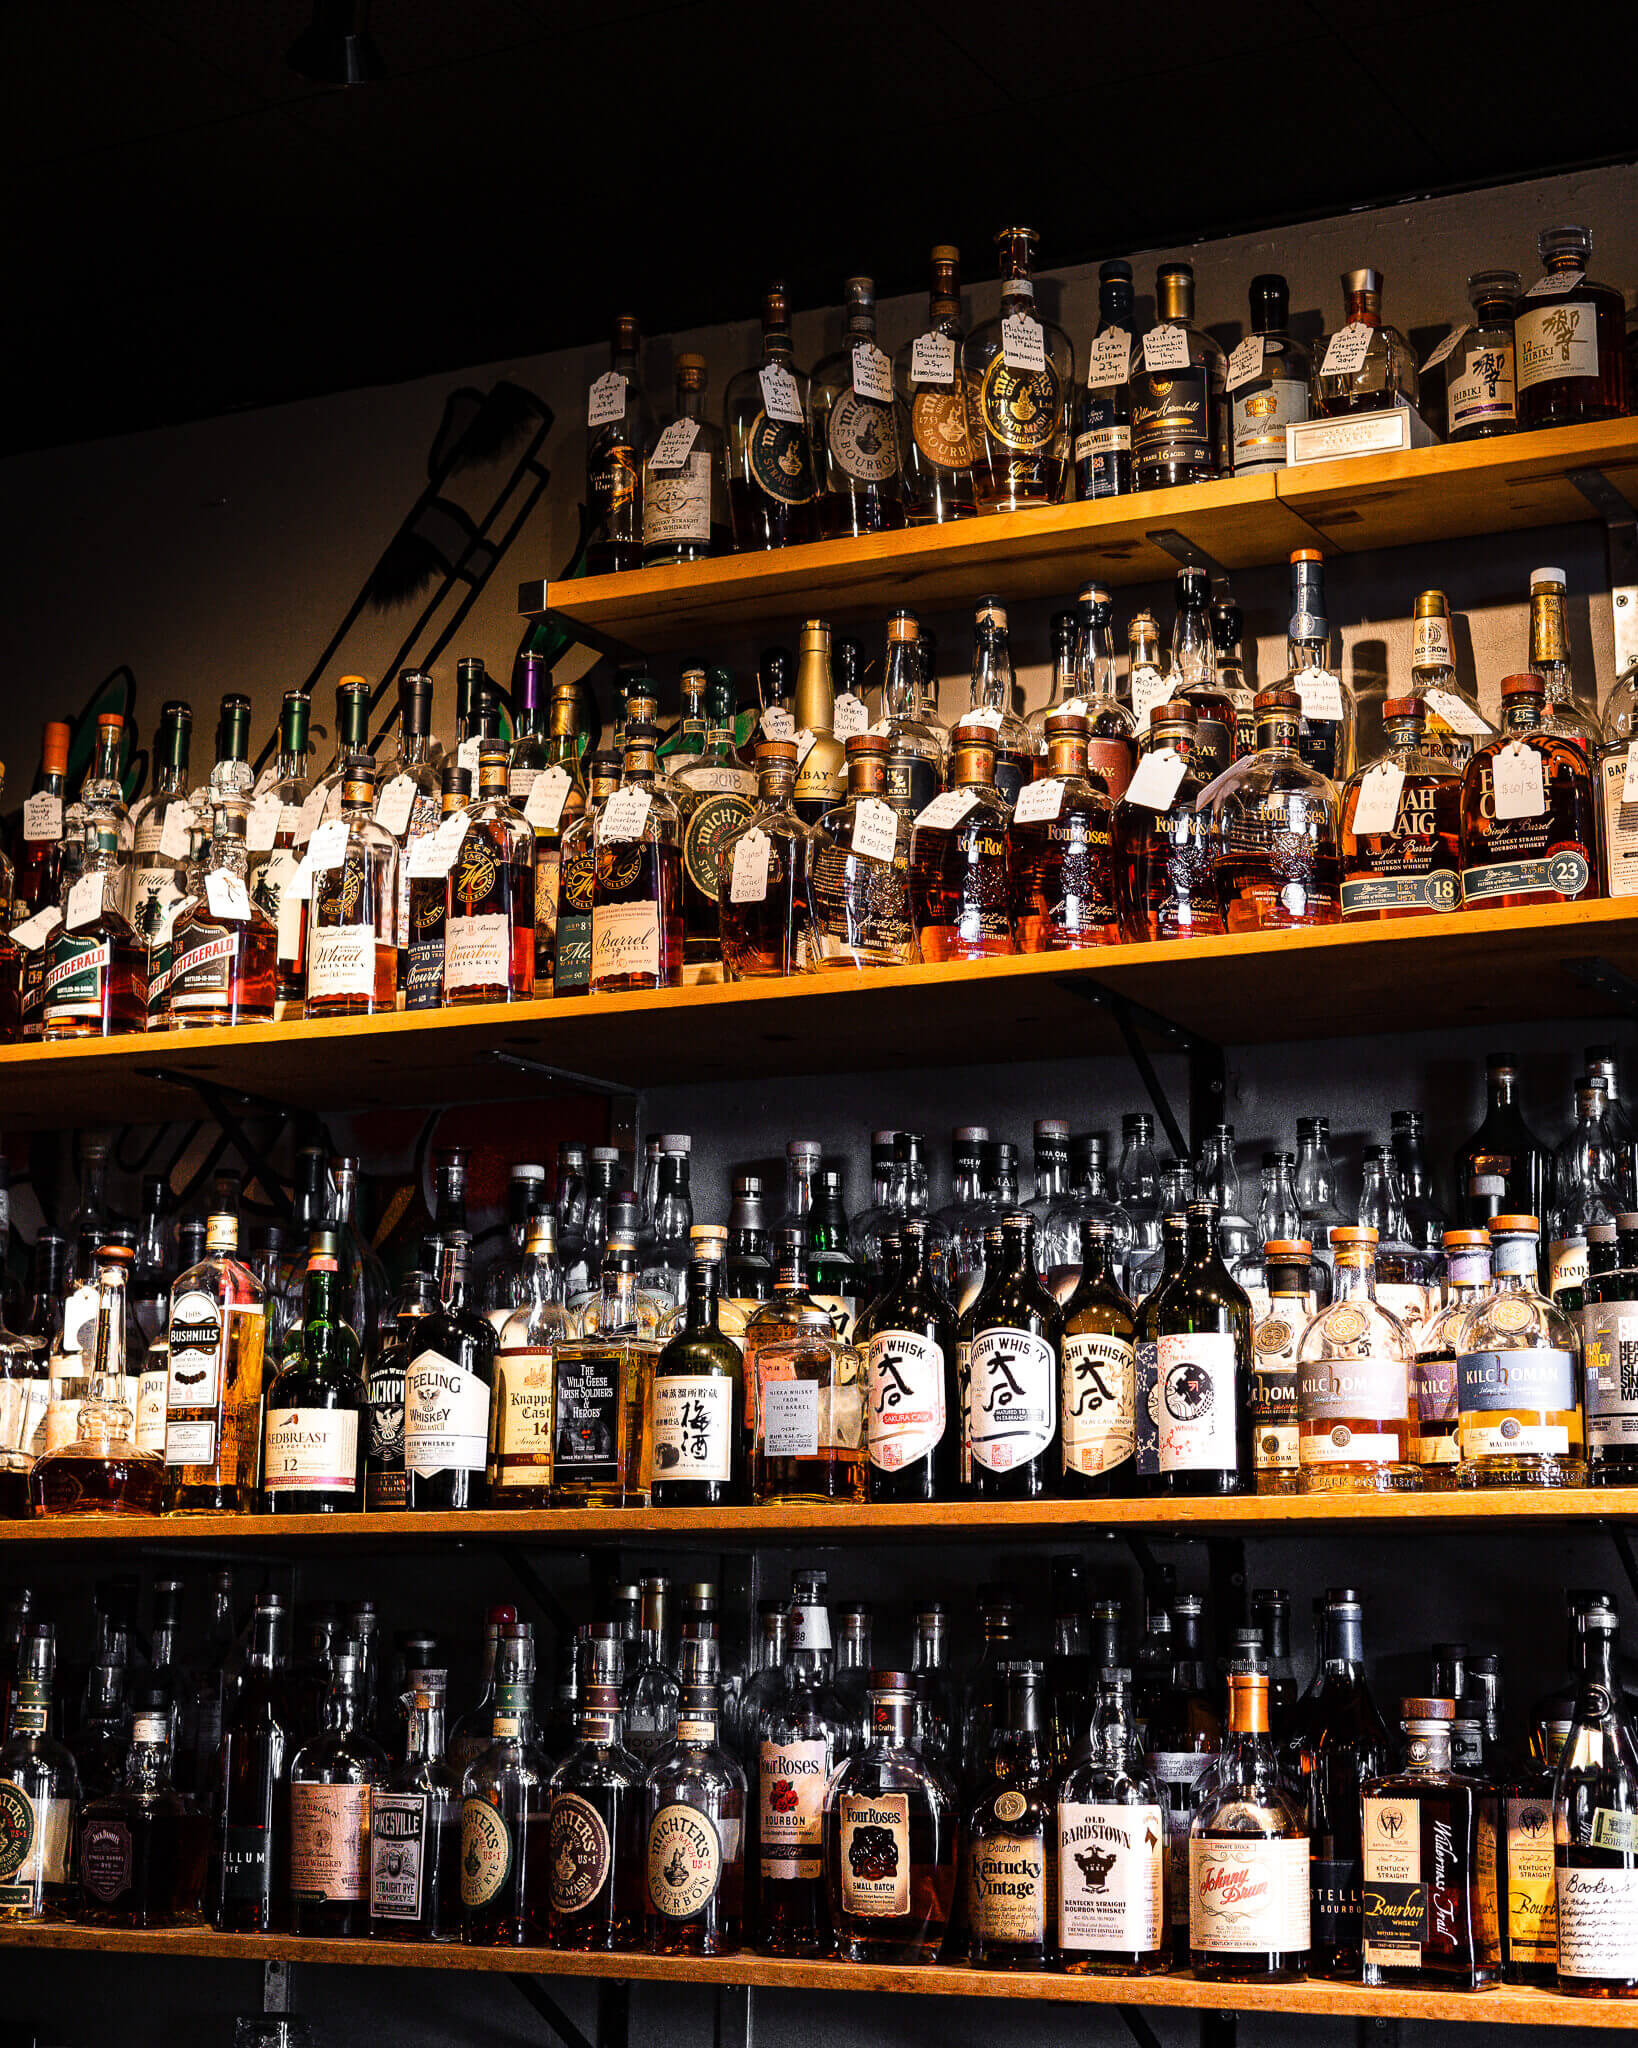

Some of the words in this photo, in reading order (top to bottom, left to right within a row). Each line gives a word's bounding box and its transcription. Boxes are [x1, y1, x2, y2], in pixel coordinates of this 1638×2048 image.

[1147, 333, 1183, 342] William
[1098, 343, 1122, 352] Evan
[1522, 341, 1532, 354] 12
[917, 351, 950, 359] Bourbon
[1093, 352, 1126, 361] Williams
[1523, 348, 1553, 363] HIBIKI
[773, 388, 791, 398] Rye
[1453, 387, 1481, 402] HIBIKI
[1158, 451, 1168, 460] 16
[1514, 711, 1526, 721] 23
[1275, 724, 1295, 738] 130
[1399, 732, 1409, 742] 18
[1420, 743, 1470, 758] CROW
[710, 772, 742, 789] 2018
[863, 808, 893, 825] 2015
[861, 821, 894, 837] Release
[1483, 820, 1511, 838] Single
[1515, 819, 1555, 834] Barrel
[1399, 840, 1439, 854] Barrel
[1488, 839, 1517, 847] KENTUCKY
[1519, 835, 1548, 843] STRAIGHT
[1557, 862, 1579, 880] 23
[456, 872, 493, 903] COLLECTION
[1433, 881, 1454, 899] 18
[580, 922, 586, 930] 8
[596, 926, 656, 952] Barrel
[316, 944, 361, 964] Wheat
[448, 937, 504, 961] Bourbon
[176, 937, 234, 976] FITZGERALD
[421, 952, 431, 961] 10
[448, 959, 500, 968] WHISKEY
[48, 949, 105, 985] FITZGERALD
[313, 962, 366, 970] WHISKEY
[170, 1329, 218, 1342] BUSHMILLS
[887, 1340, 926, 1359] WHISK
[999, 1338, 1047, 1364] WHISY
[1088, 1344, 1133, 1368] WHISKY
[580, 1365, 594, 1375] THE
[408, 1372, 461, 1394] TEELING
[567, 1376, 583, 1387] WILD
[584, 1376, 608, 1386] GEESE
[561, 1388, 579, 1399] IRISH
[580, 1387, 613, 1398] SOLDIERS
[583, 1398, 589, 1409] &
[409, 1408, 451, 1423] WHISKEY
[573, 1407, 600, 1417] HEROES
[533, 1422, 548, 1435] 14
[267, 1431, 327, 1444] REDBREAST
[283, 1458, 298, 1471] 12
[374, 1812, 420, 1835] PIKESVILLE
[766, 1816, 805, 1826] BOURBON
[1085, 1816, 1105, 1824] OLD
[653, 1818, 709, 1858] MICHTER'S
[1061, 1824, 1131, 1850] BARDSTOWN
[678, 1834, 696, 1858] BATCH
[987, 1841, 1021, 1853] Bourbon
[1433, 1820, 1458, 1891] Wilderness
[486, 1863, 499, 1885] RYE
[973, 1855, 1041, 1880] Kentucky
[1376, 1865, 1410, 1873] KENTUCKY
[375, 1882, 401, 1893] STRAIGHT
[403, 1882, 415, 1894] RYE
[565, 1872, 592, 1897] MASH
[853, 1882, 872, 1891] SMALL
[874, 1883, 895, 1891] BATCH
[1201, 1867, 1249, 1896] Johnny
[651, 1877, 710, 1907] BOURBON
[975, 1879, 1034, 1899] Vintage
[1220, 1881, 1268, 1905] Drum
[382, 1894, 408, 1902] WHISKEY
[1365, 1889, 1424, 1917] Bourbon
[1392, 1919, 1419, 1927] WHISKEY
[1434, 1893, 1458, 1945] Trail
[1018, 1929, 1037, 1938] Mash
